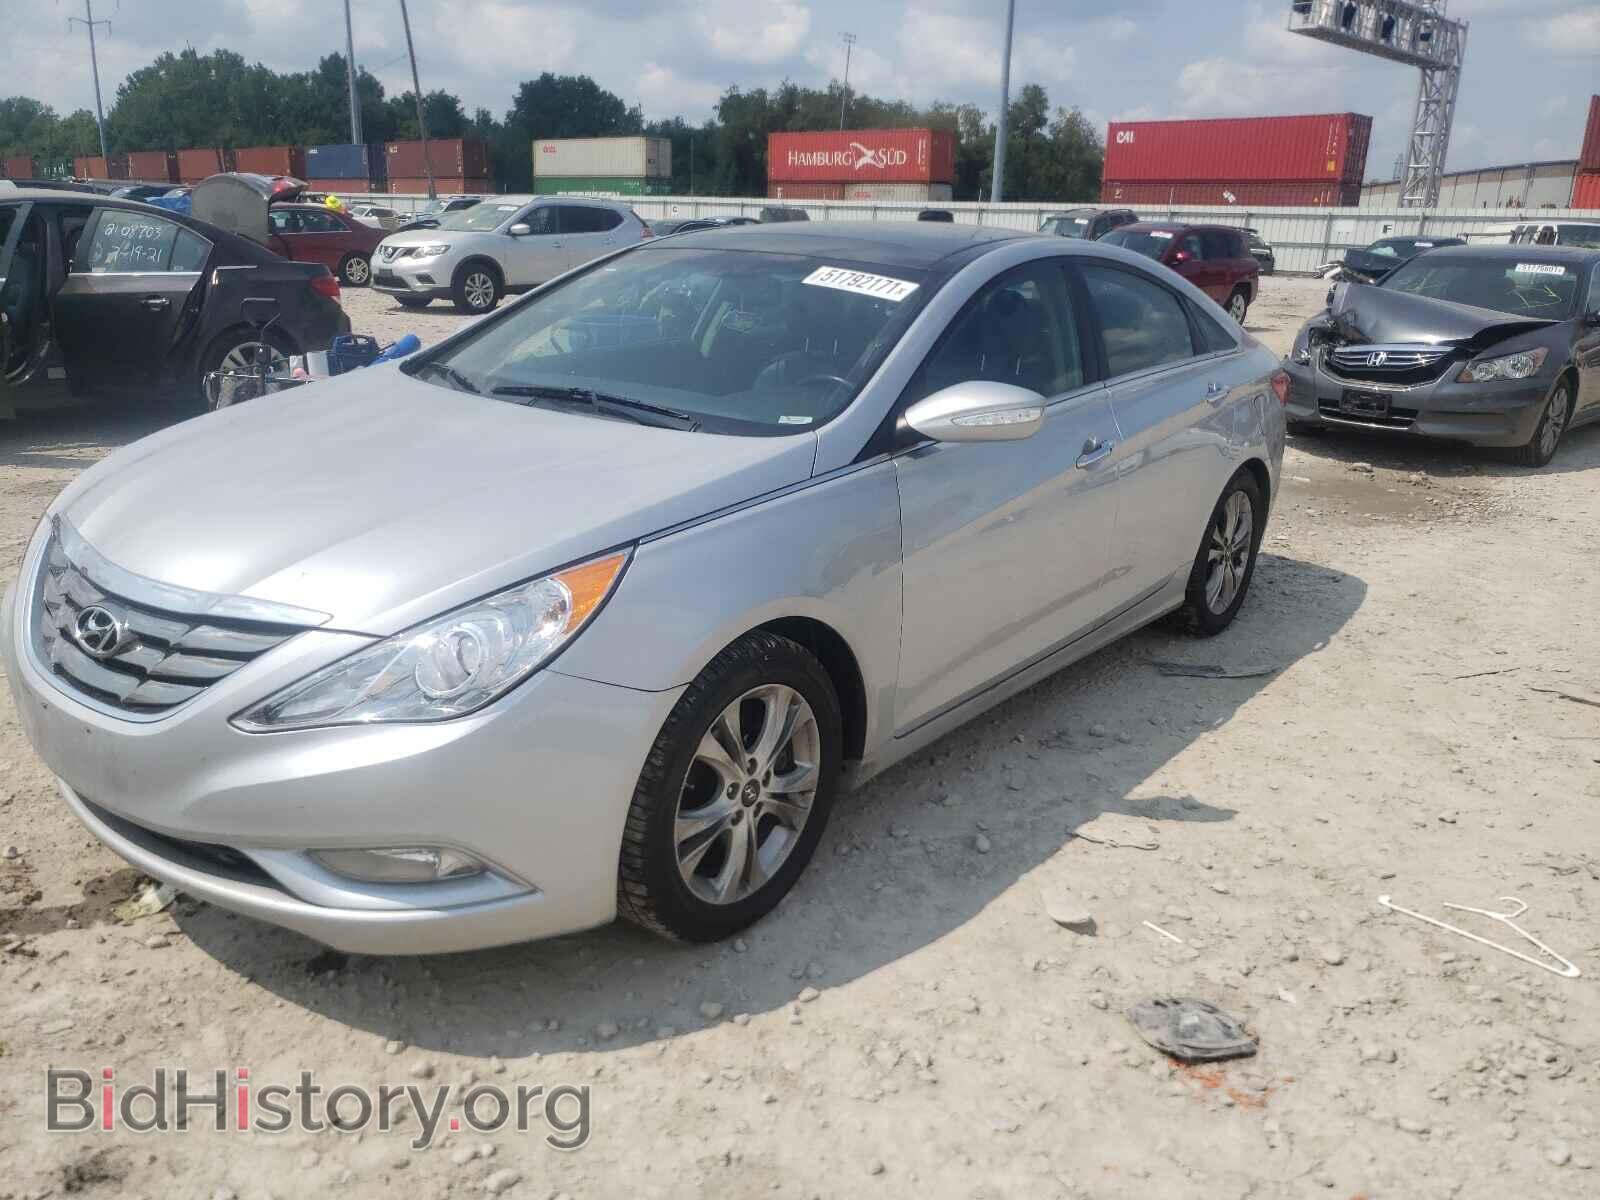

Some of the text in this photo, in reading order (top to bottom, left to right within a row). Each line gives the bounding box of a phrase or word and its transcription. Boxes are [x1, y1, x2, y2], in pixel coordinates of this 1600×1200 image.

[1116, 131, 1135, 144] CAI
[788, 150, 852, 166] HAMBURG
[879, 147, 907, 166] SÜD
